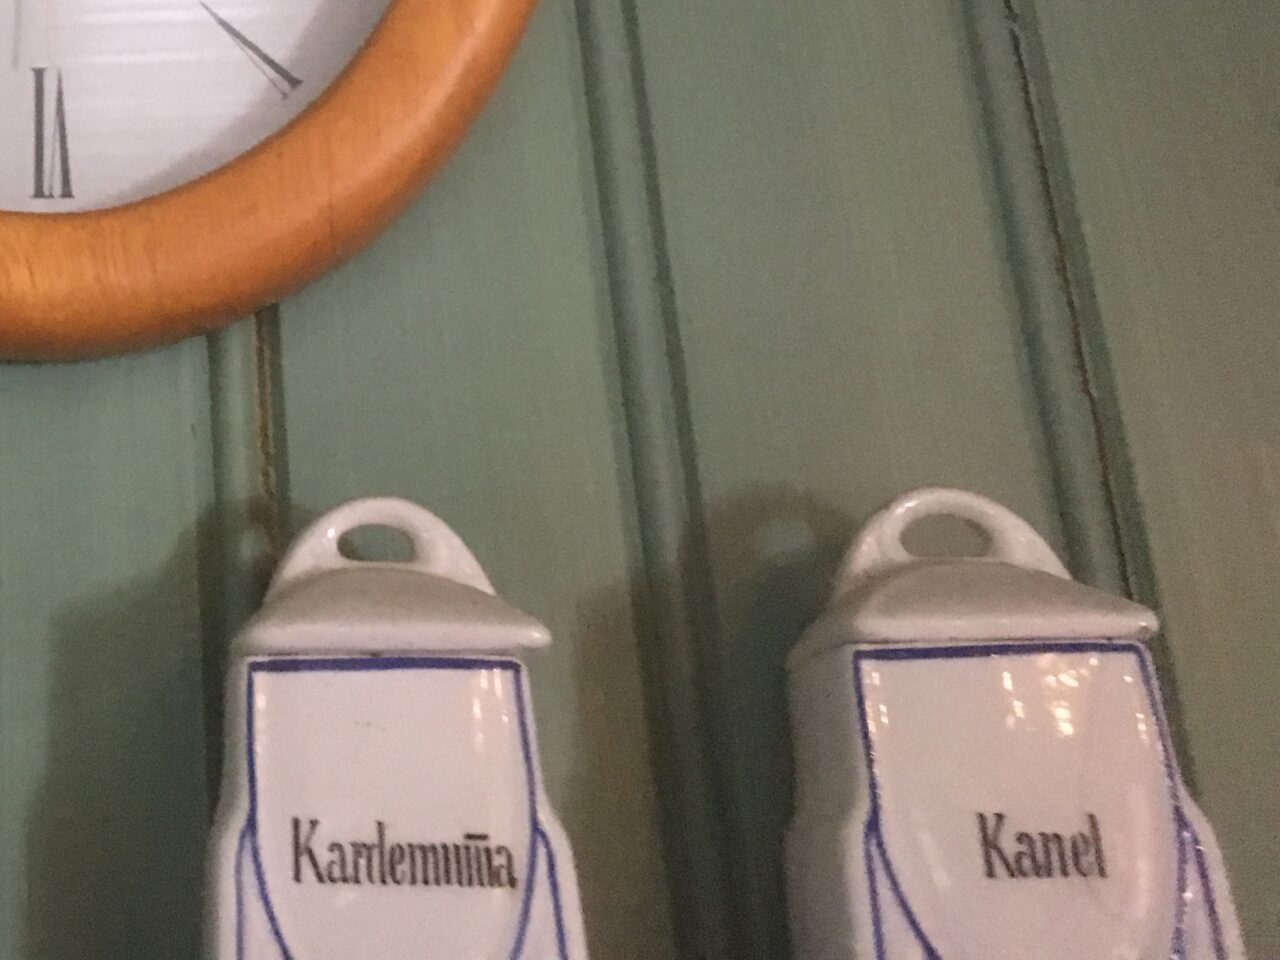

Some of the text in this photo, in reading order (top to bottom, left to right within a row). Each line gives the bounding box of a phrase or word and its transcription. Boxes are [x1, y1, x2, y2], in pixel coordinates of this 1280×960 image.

[199, 1, 302, 100] V
[31, 66, 75, 199] VI
[977, 812, 1107, 879] Kanel
